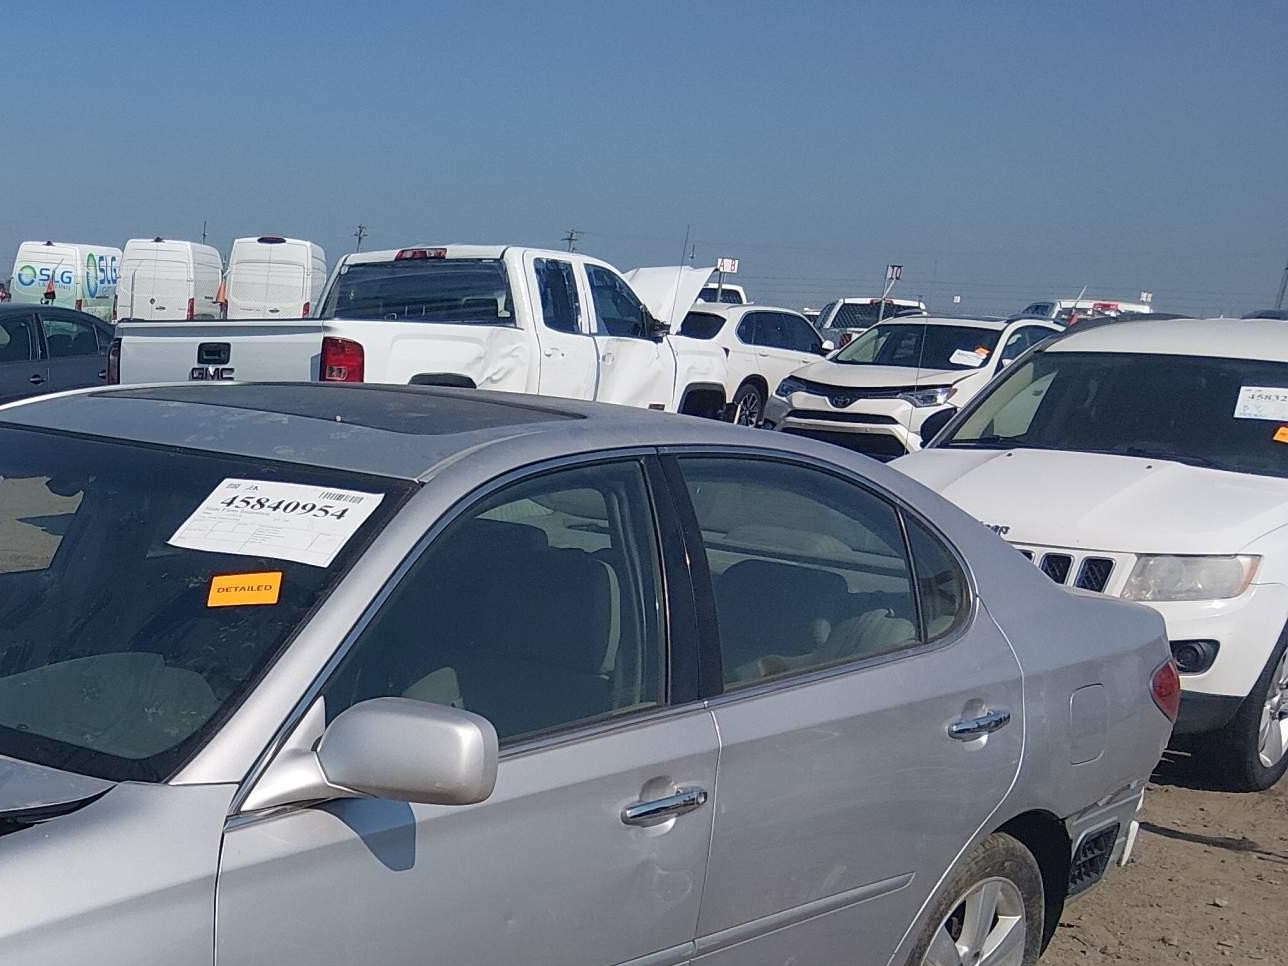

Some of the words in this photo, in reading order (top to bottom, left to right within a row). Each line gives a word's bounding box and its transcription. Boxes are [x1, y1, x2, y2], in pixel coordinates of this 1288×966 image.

[190, 367, 234, 380] GMC
[220, 495, 349, 519] 45840954
[216, 584, 273, 594] DETAILED
